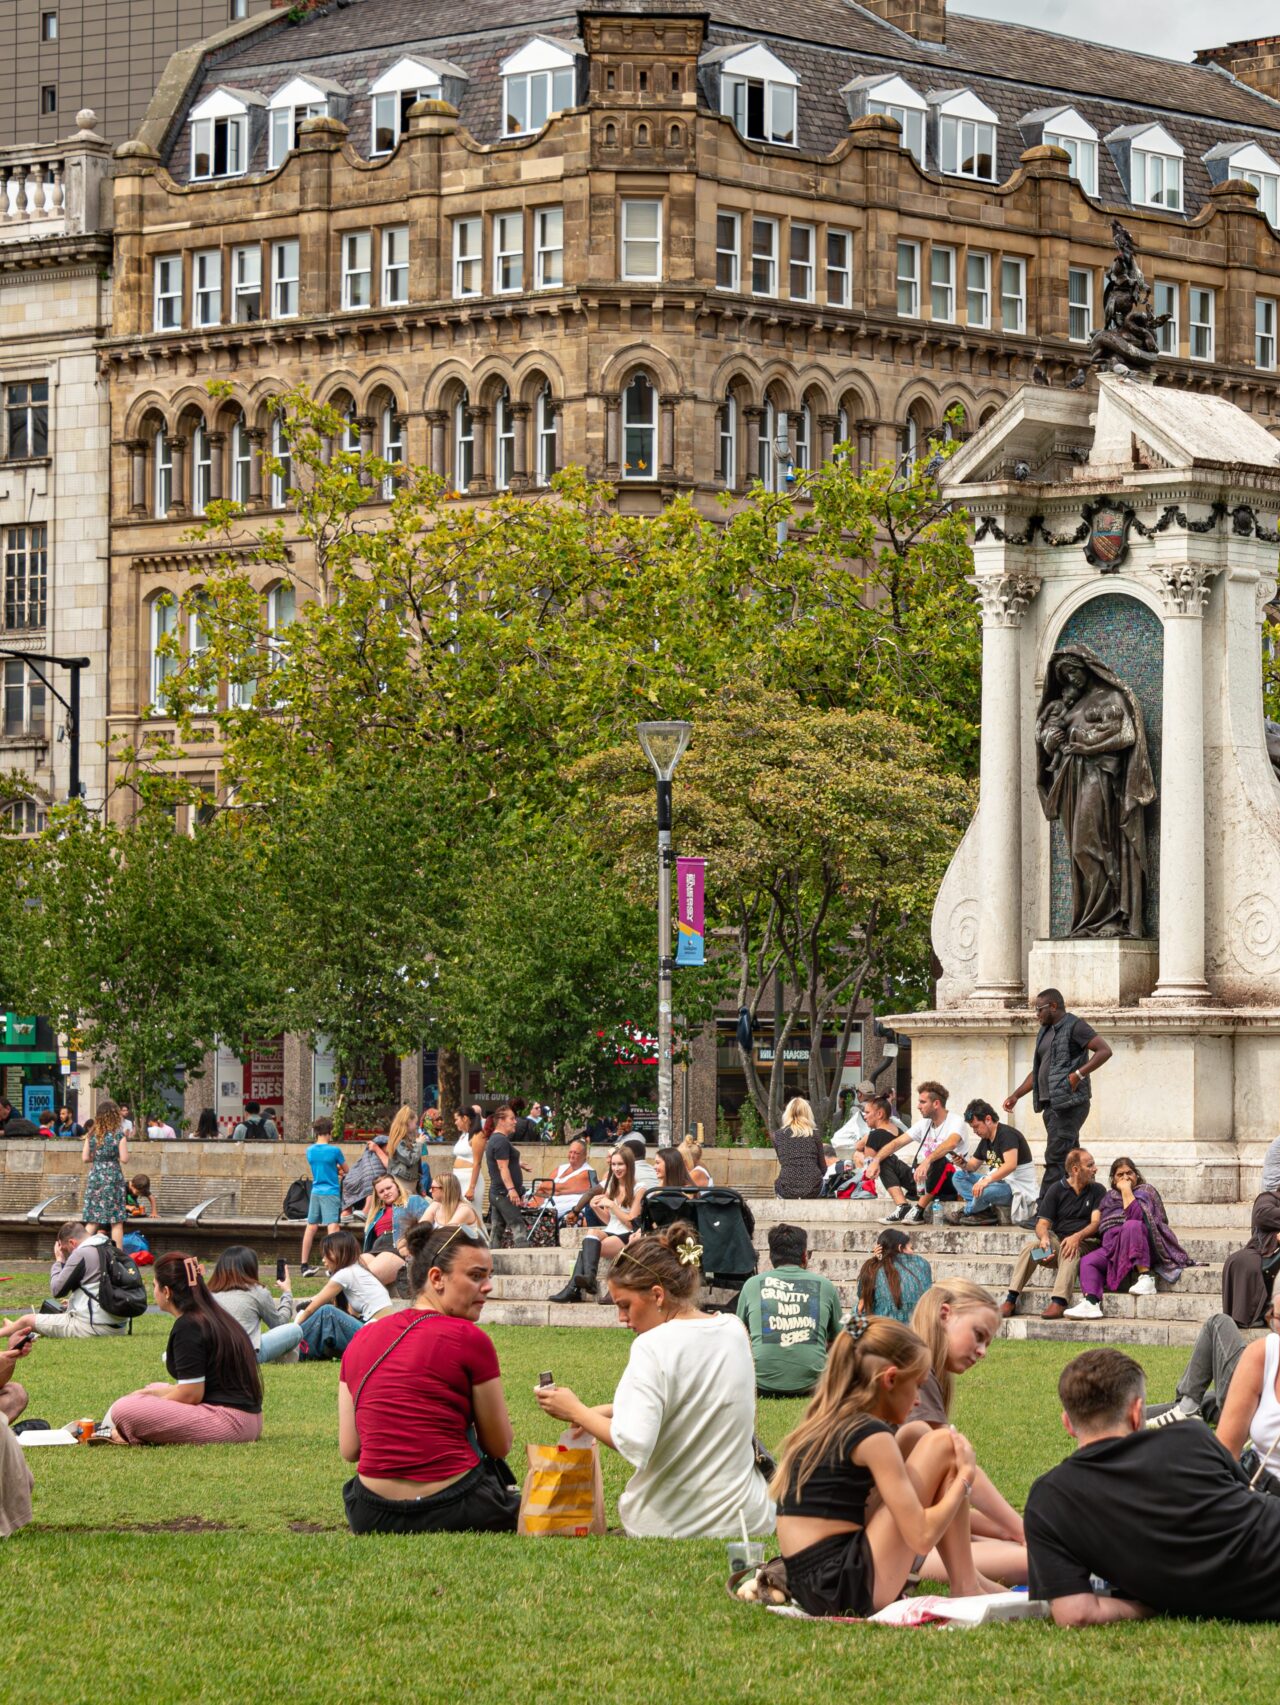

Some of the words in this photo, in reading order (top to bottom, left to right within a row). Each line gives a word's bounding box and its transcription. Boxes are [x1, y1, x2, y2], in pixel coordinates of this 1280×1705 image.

[251, 1082, 284, 1098] FRES
[474, 1093, 490, 1101] FIVE
[491, 1093, 510, 1101] GUYS
[29, 1096, 50, 1106] £1000
[764, 1276, 795, 1291] DEFY
[760, 1287, 810, 1303] GRAVITY
[777, 1302, 801, 1316] AND
[768, 1315, 817, 1330] COMMON
[780, 1329, 810, 1348] SENSE
